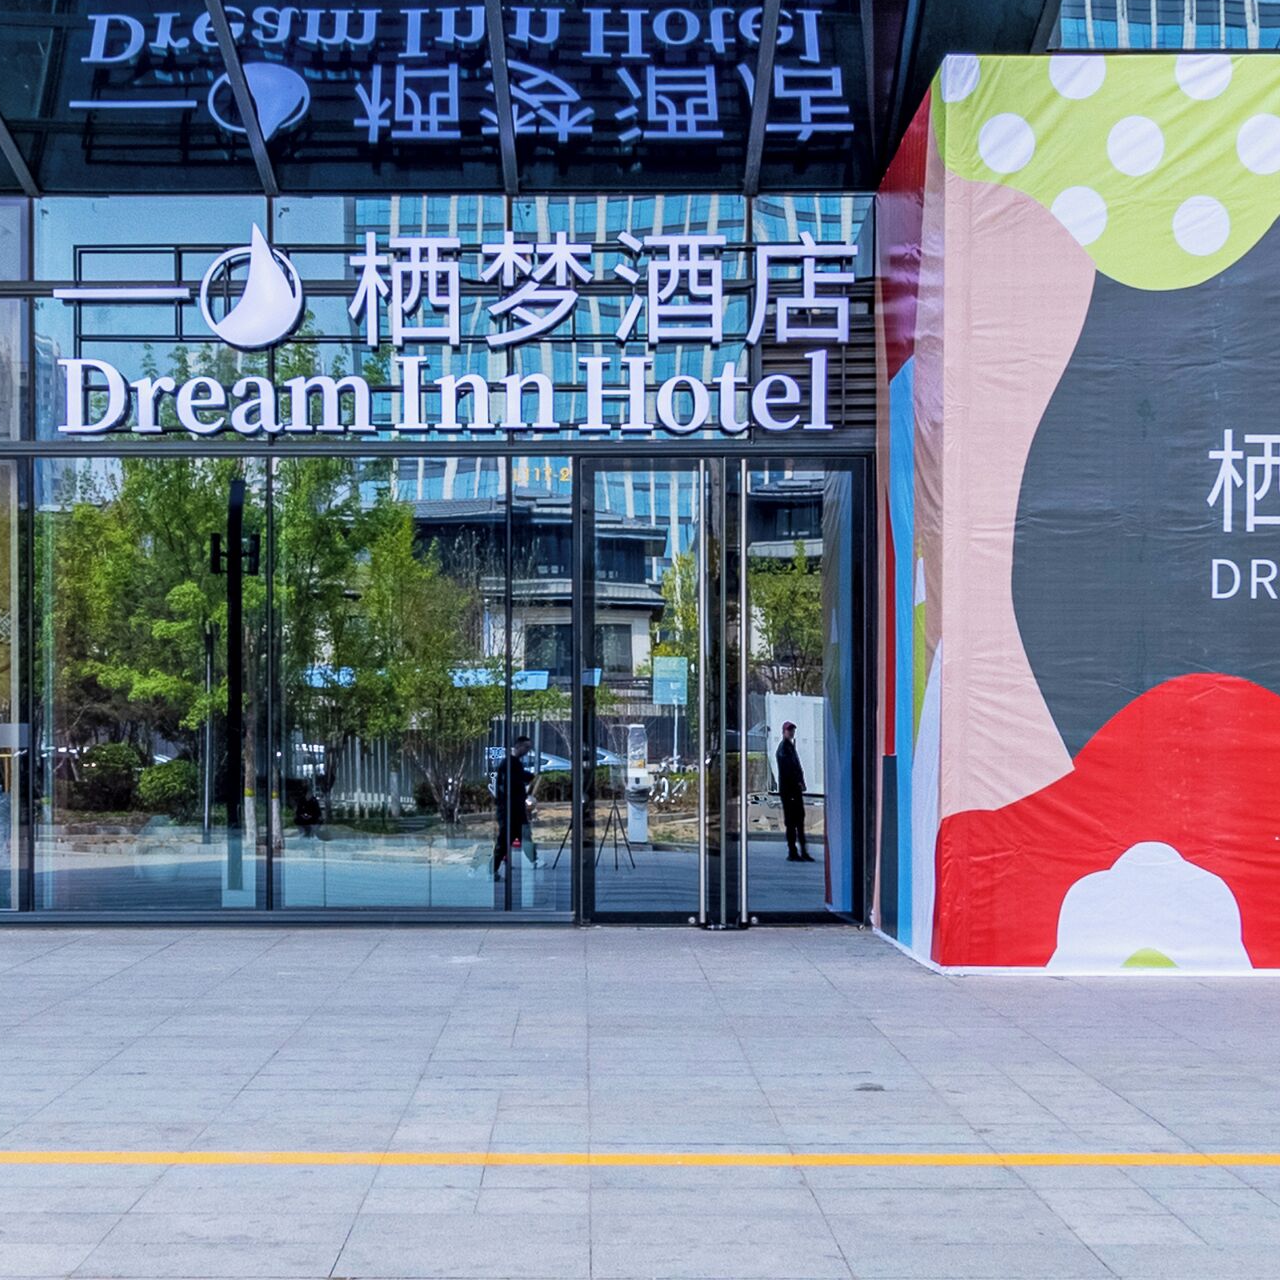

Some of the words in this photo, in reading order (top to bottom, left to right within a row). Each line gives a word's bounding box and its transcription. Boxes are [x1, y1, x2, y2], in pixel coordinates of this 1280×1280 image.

[348, 229, 858, 348] 栖梦酒店
[57, 357, 376, 435] Dream
[393, 354, 560, 432] Inn
[577, 349, 835, 432] Hotel
